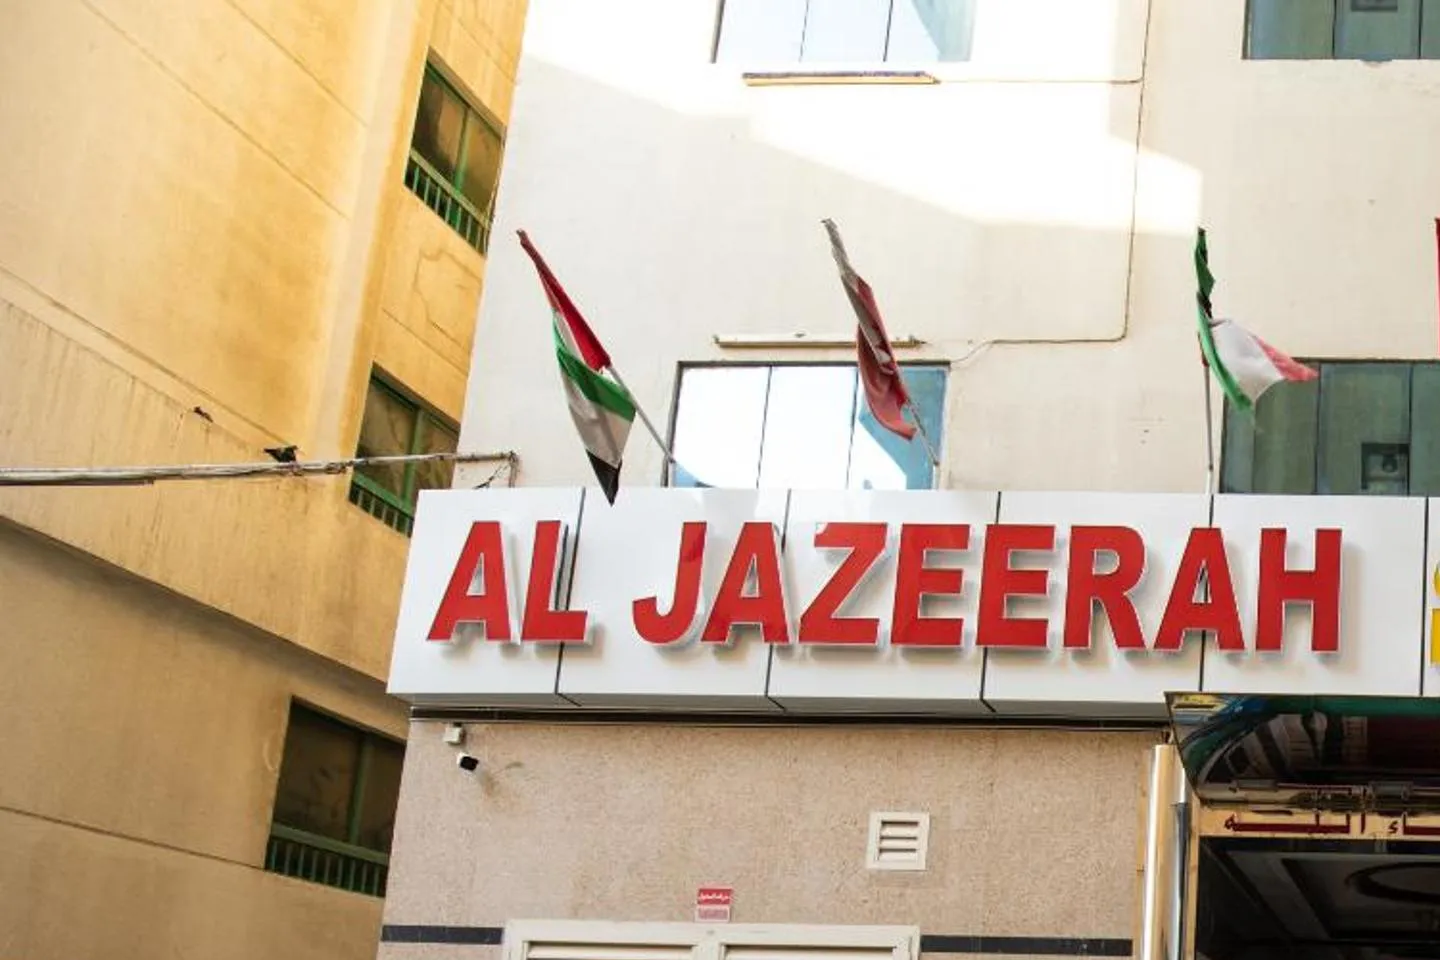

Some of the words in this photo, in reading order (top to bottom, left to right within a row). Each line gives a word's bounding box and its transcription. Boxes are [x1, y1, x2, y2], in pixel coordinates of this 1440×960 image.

[427, 520, 588, 642] AL
[631, 521, 1343, 653] JAZEERAH
[1223, 811, 1367, 836] الله
